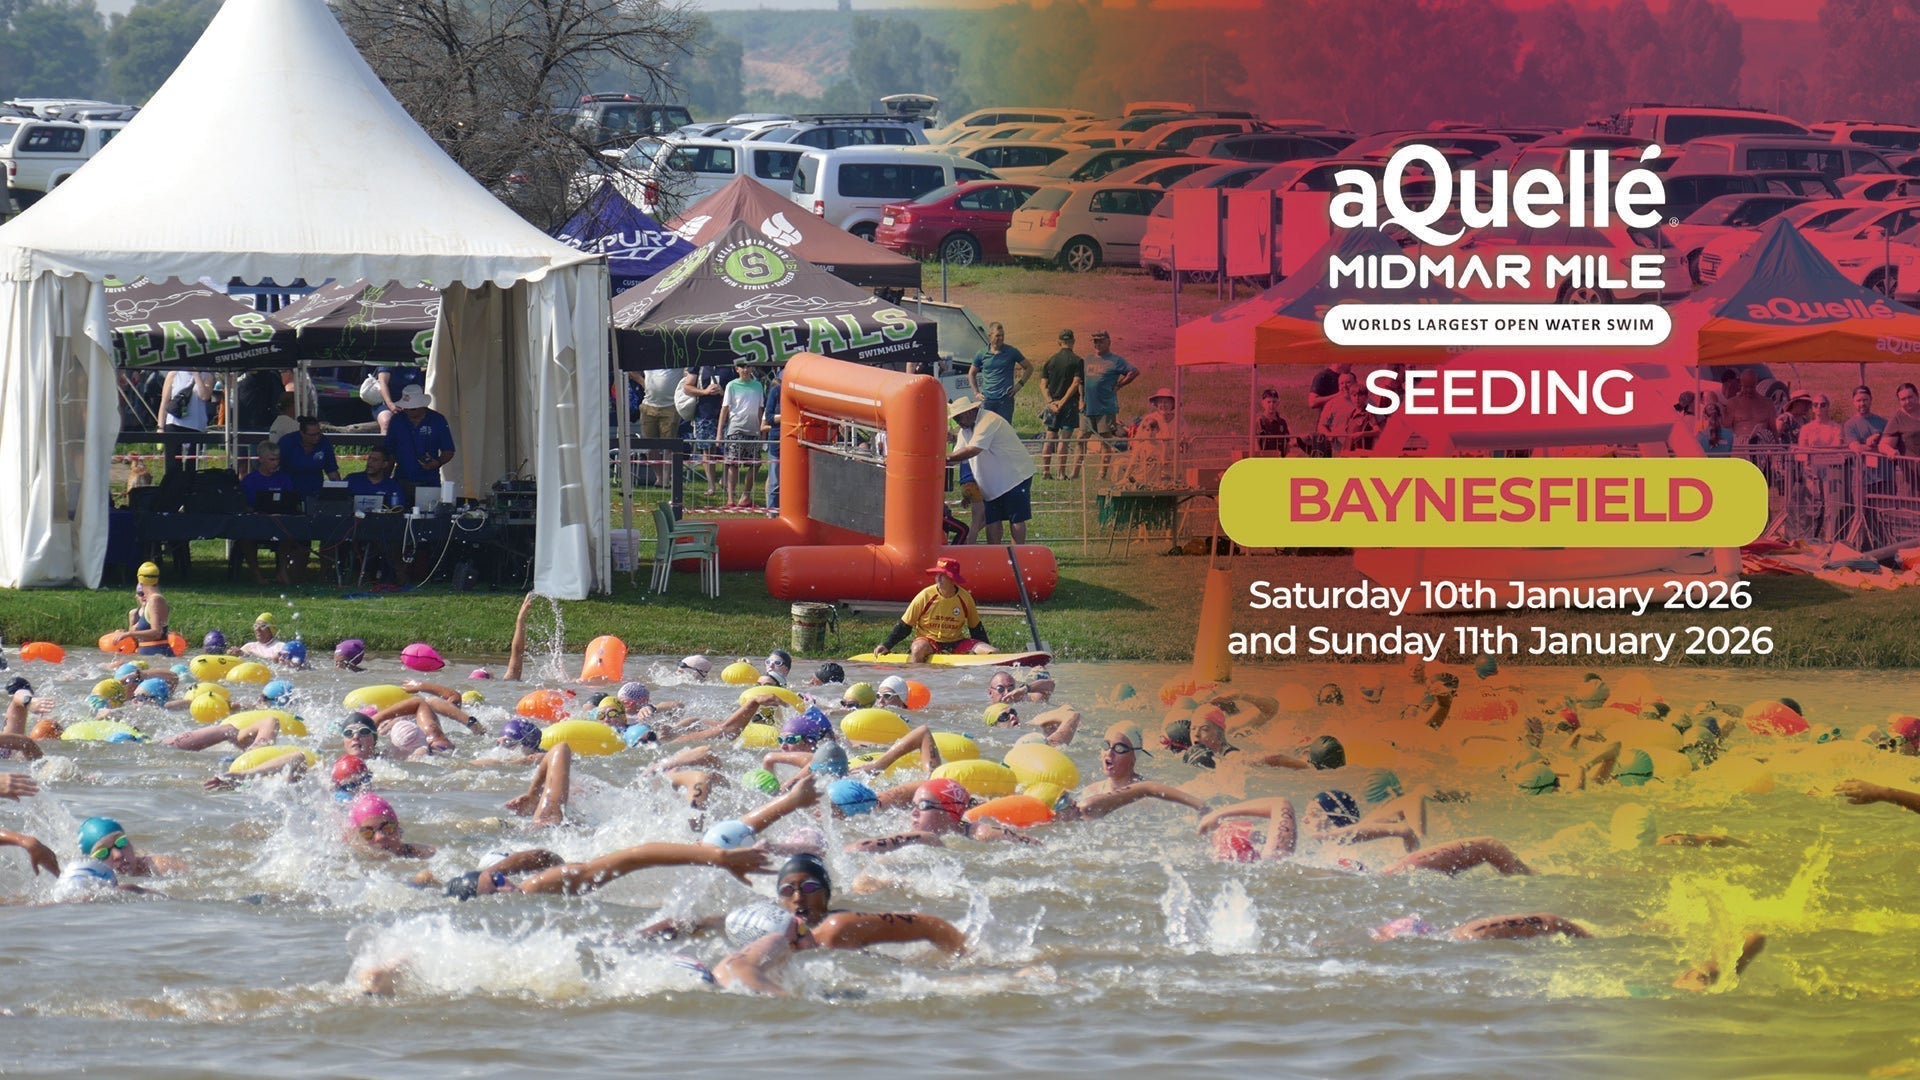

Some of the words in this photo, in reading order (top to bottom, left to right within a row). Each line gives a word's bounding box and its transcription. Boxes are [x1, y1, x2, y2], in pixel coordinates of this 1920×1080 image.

[111, 312, 276, 367] EALS
[728, 308, 918, 364] SEALS
[858, 342, 911, 360] SWIMMING
